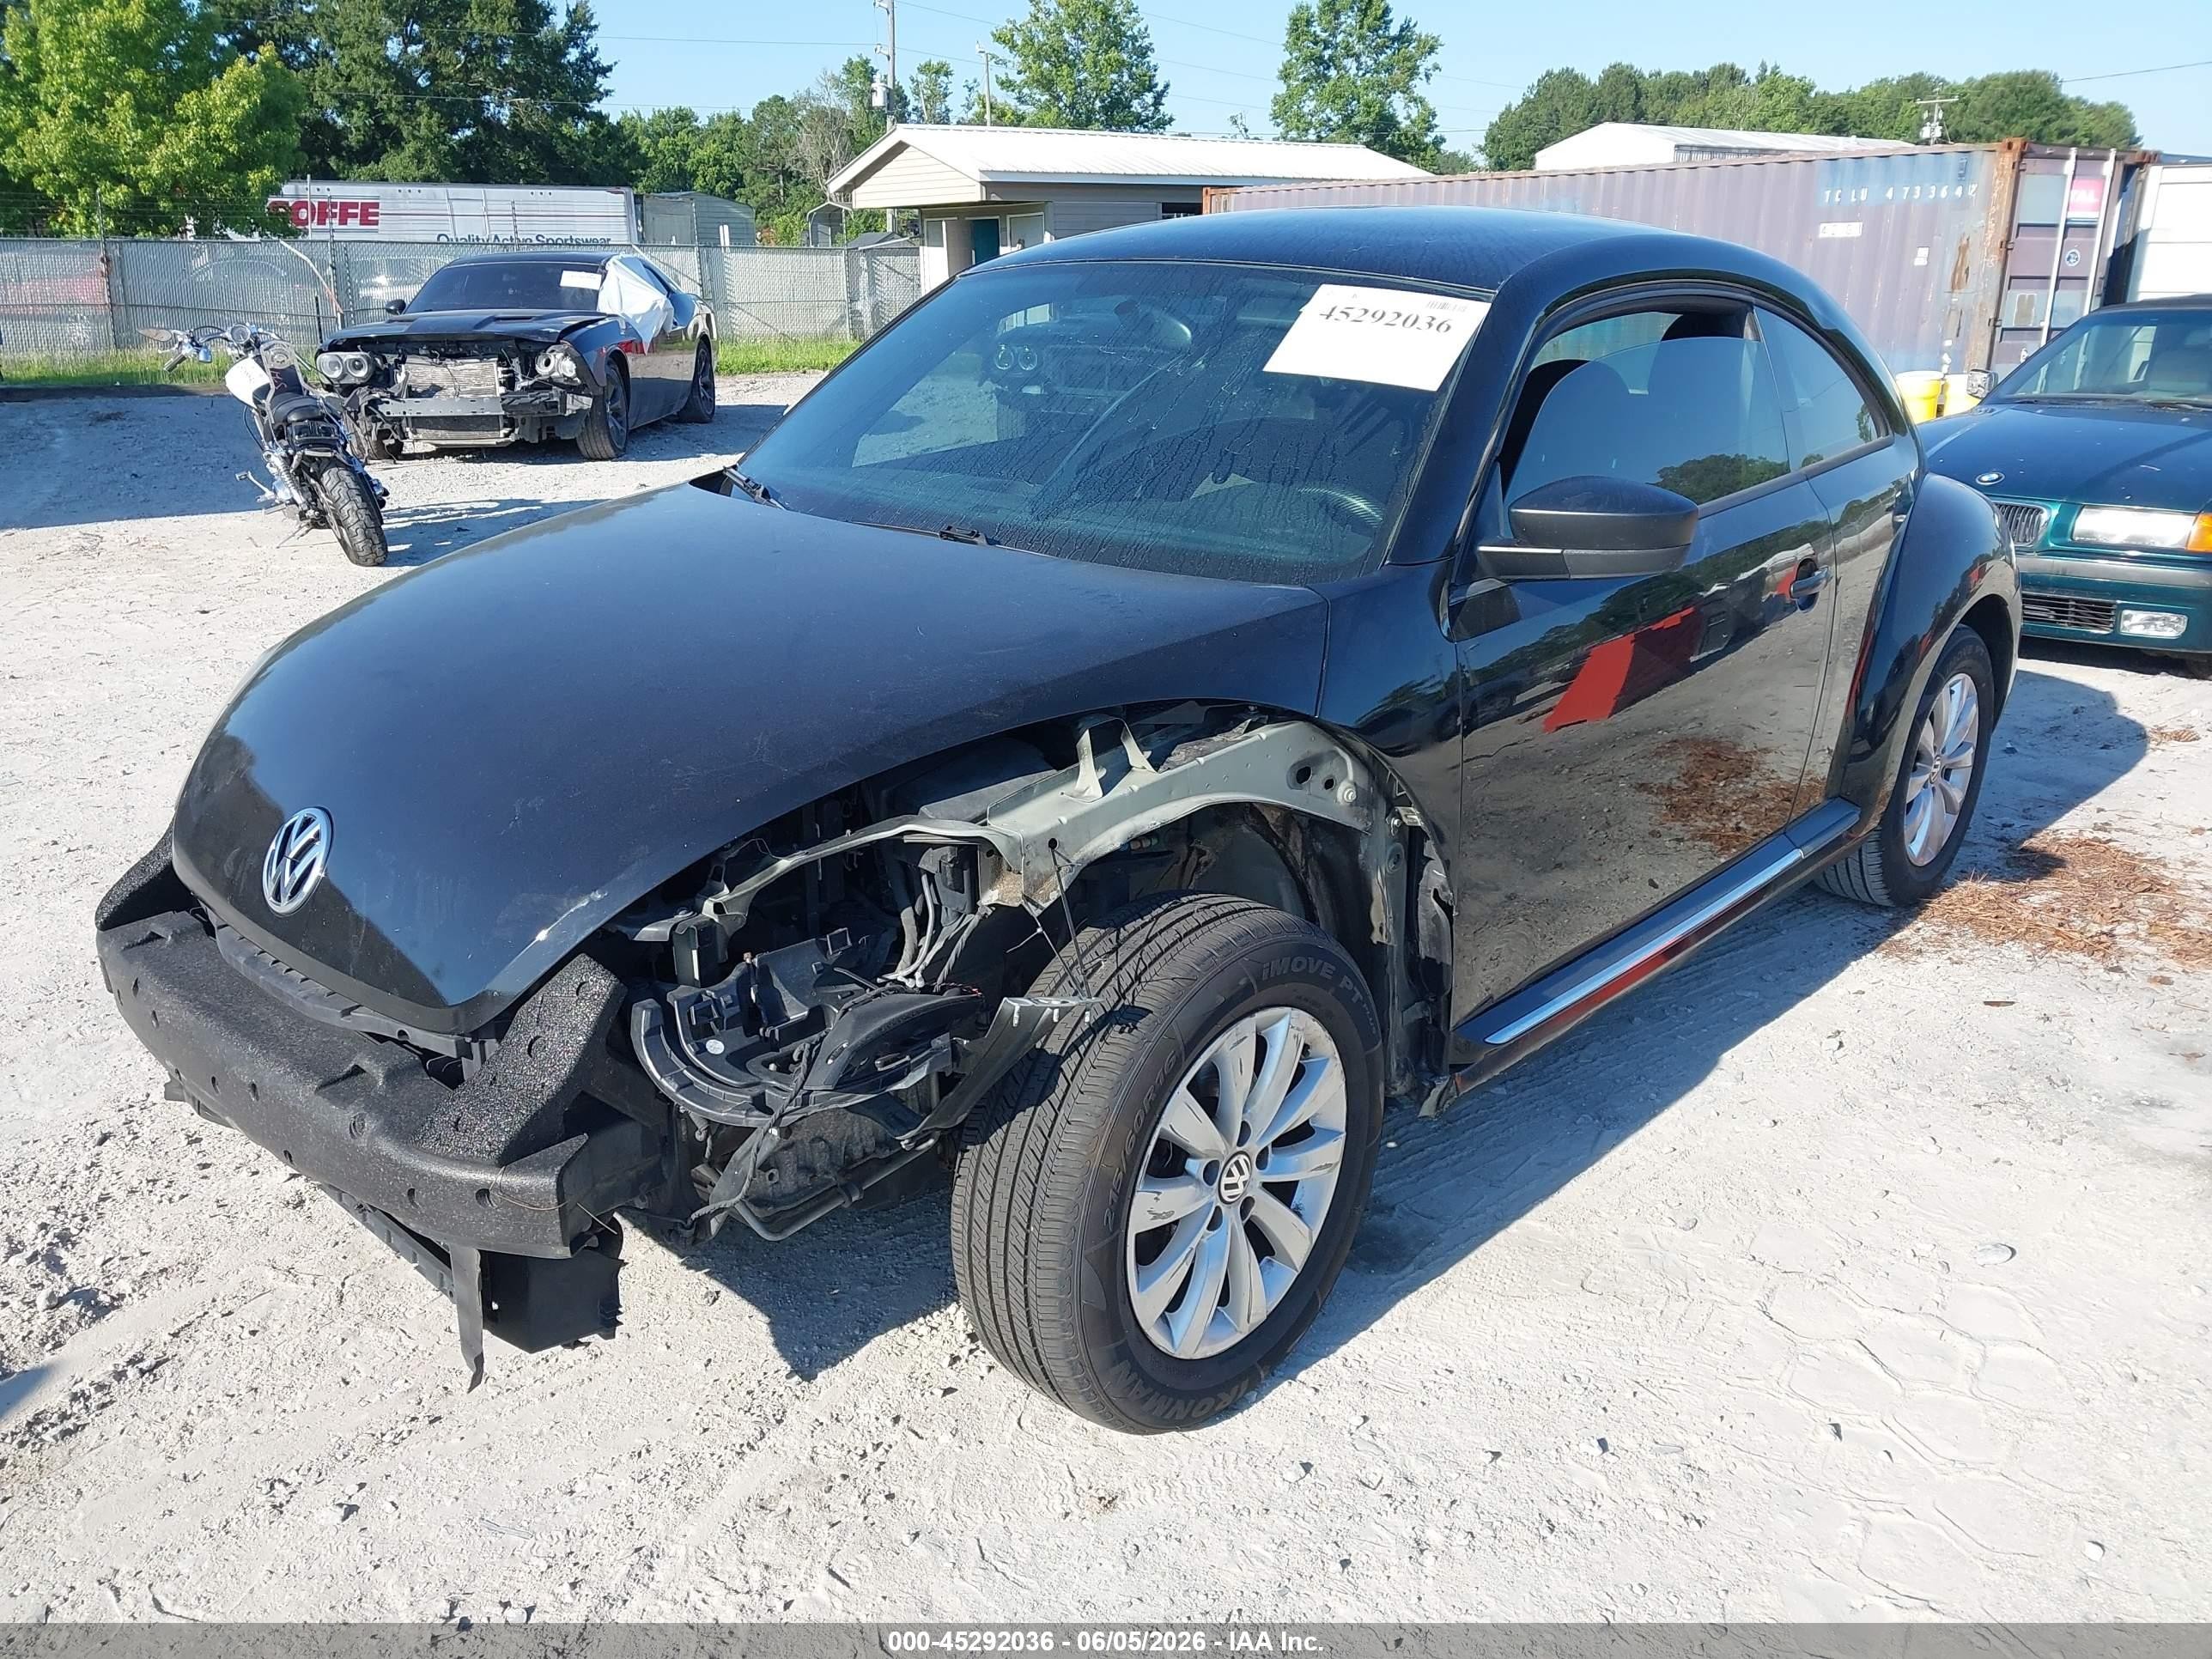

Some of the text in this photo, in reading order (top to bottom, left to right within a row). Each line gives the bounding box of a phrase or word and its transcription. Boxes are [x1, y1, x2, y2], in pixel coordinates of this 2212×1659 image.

[493, 234, 532, 243] Actve
[535, 234, 611, 245] Sportswear
[1320, 306, 1453, 333] 45292036
[1111, 1359, 1249, 1420] IRONMAN
